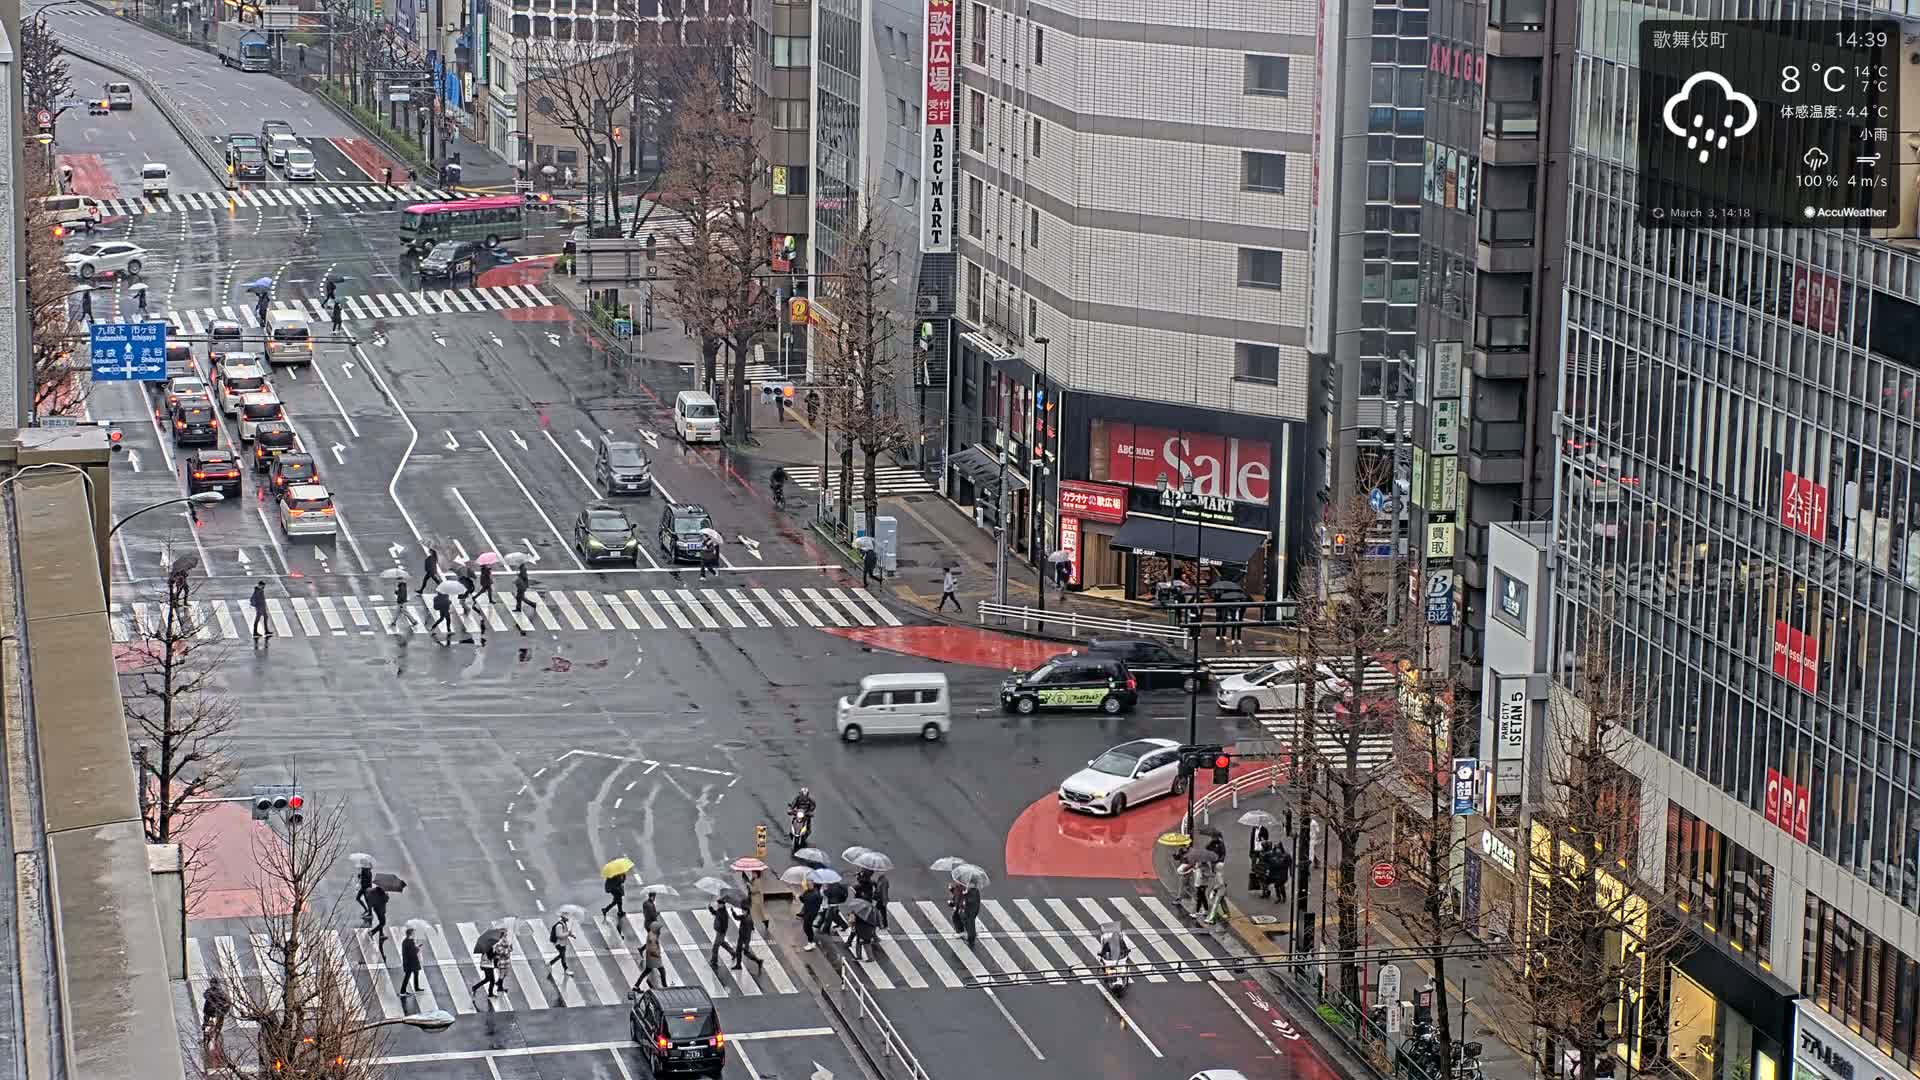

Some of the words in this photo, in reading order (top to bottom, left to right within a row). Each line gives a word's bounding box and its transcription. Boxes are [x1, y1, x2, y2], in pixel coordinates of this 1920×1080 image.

[929, 11, 951, 91] 歌広場
[1430, 42, 1484, 86] AMIGO
[928, 99, 950, 110] 受付
[928, 111, 949, 121] 5F
[97, 326, 125, 335] 九段下
[1163, 437, 1270, 501] Sale
[1062, 492, 1089, 504] カラオケ
[1786, 482, 1822, 531] 会計
[1436, 515, 1447, 523] 7F
[1431, 526, 1445, 554] 買取
[1511, 692, 1524, 702] 5
[1502, 702, 1510, 720] CITY
[1501, 721, 1509, 740] PARK
[1509, 705, 1523, 746] ISETAN
[1769, 780, 1807, 829] CPA
